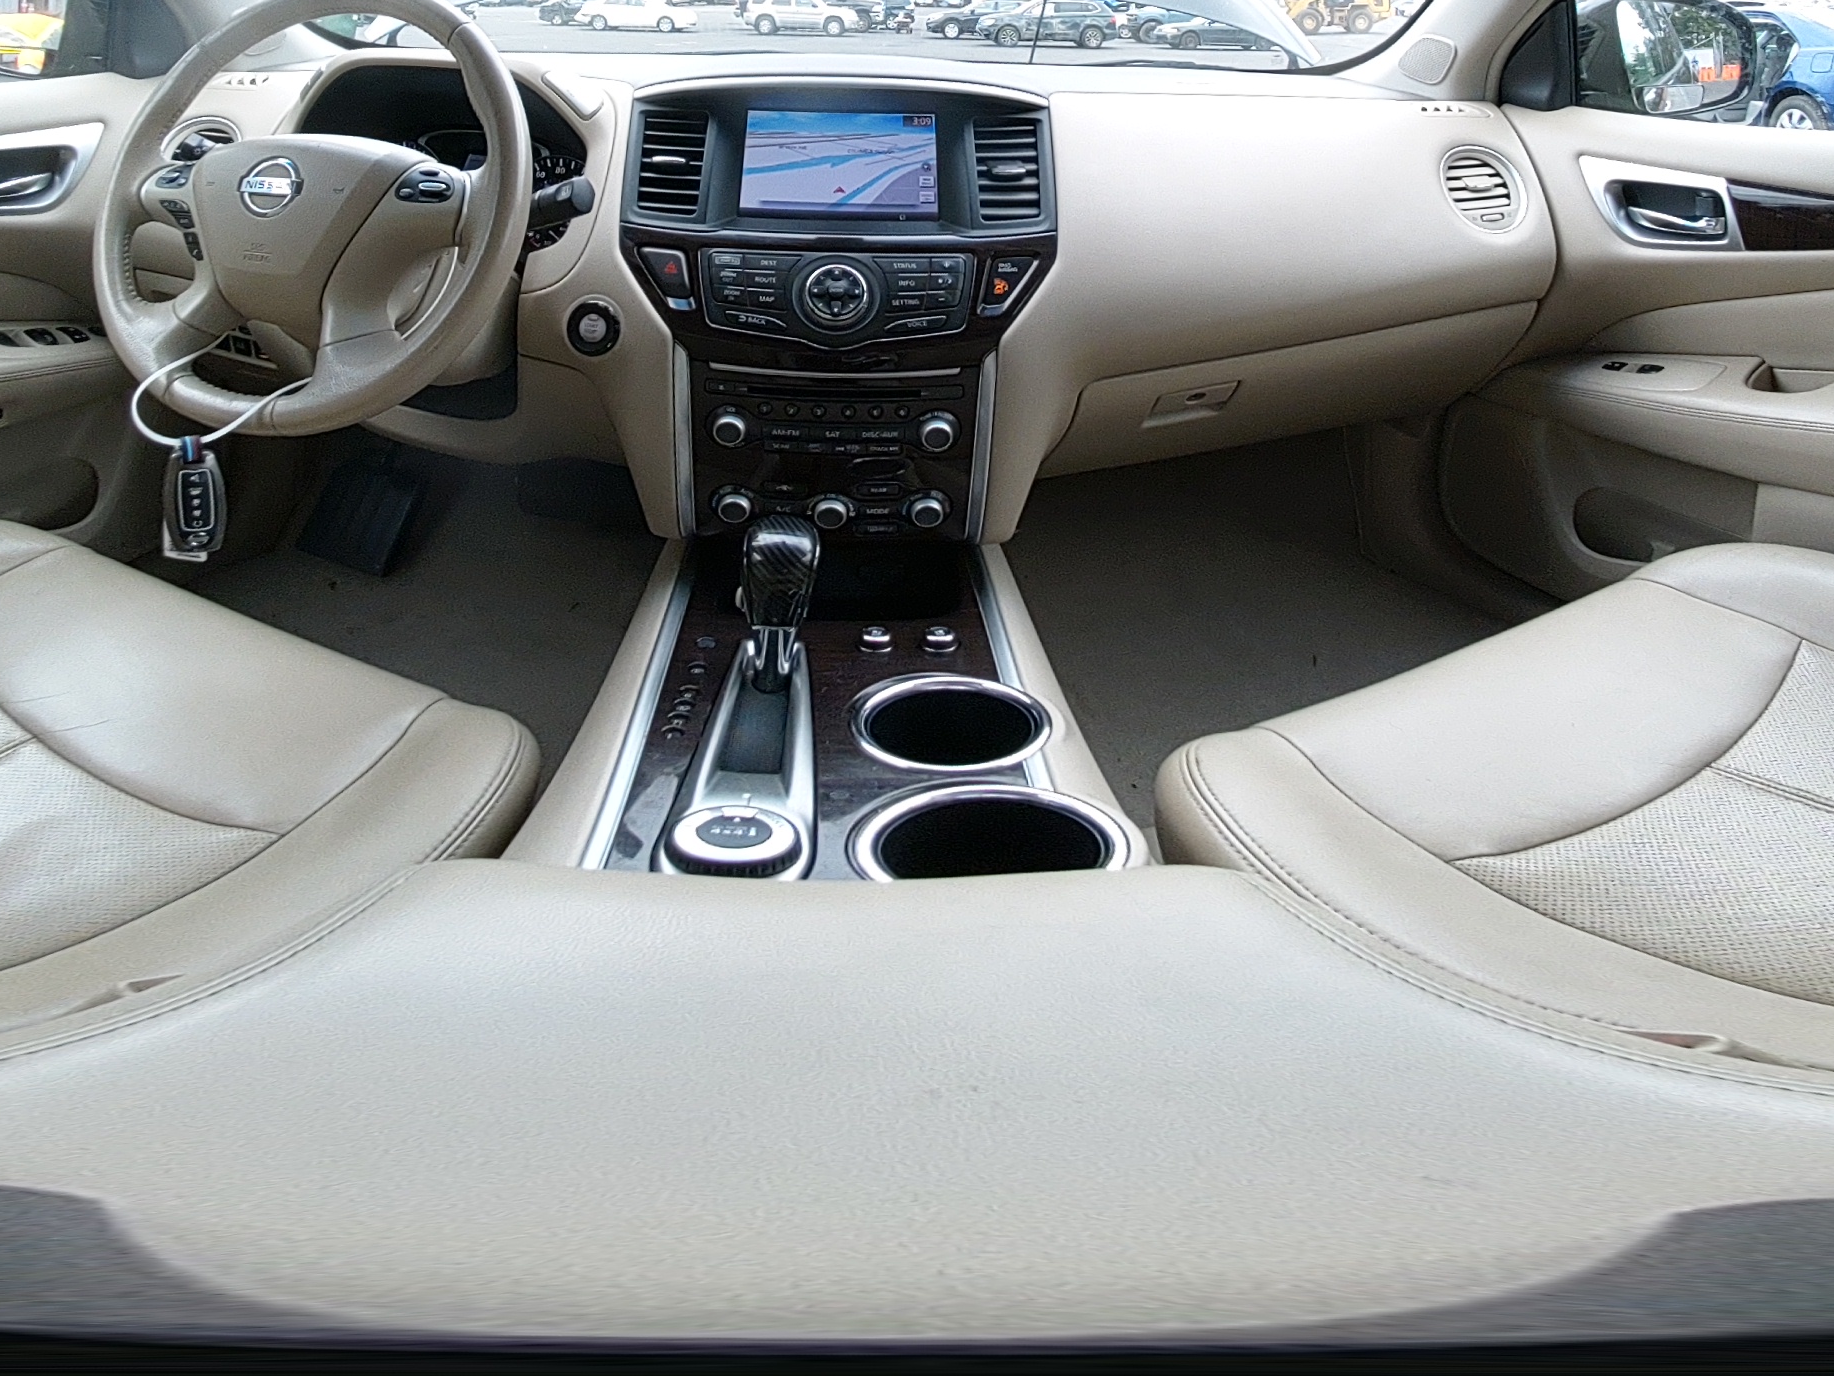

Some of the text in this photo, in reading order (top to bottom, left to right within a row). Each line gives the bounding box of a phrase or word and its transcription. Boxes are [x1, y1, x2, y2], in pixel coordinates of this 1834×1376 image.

[912, 117, 932, 126] 3:09
[244, 179, 296, 191] NISSAN
[747, 317, 766, 325] BACK
[776, 505, 791, 513] A/C
